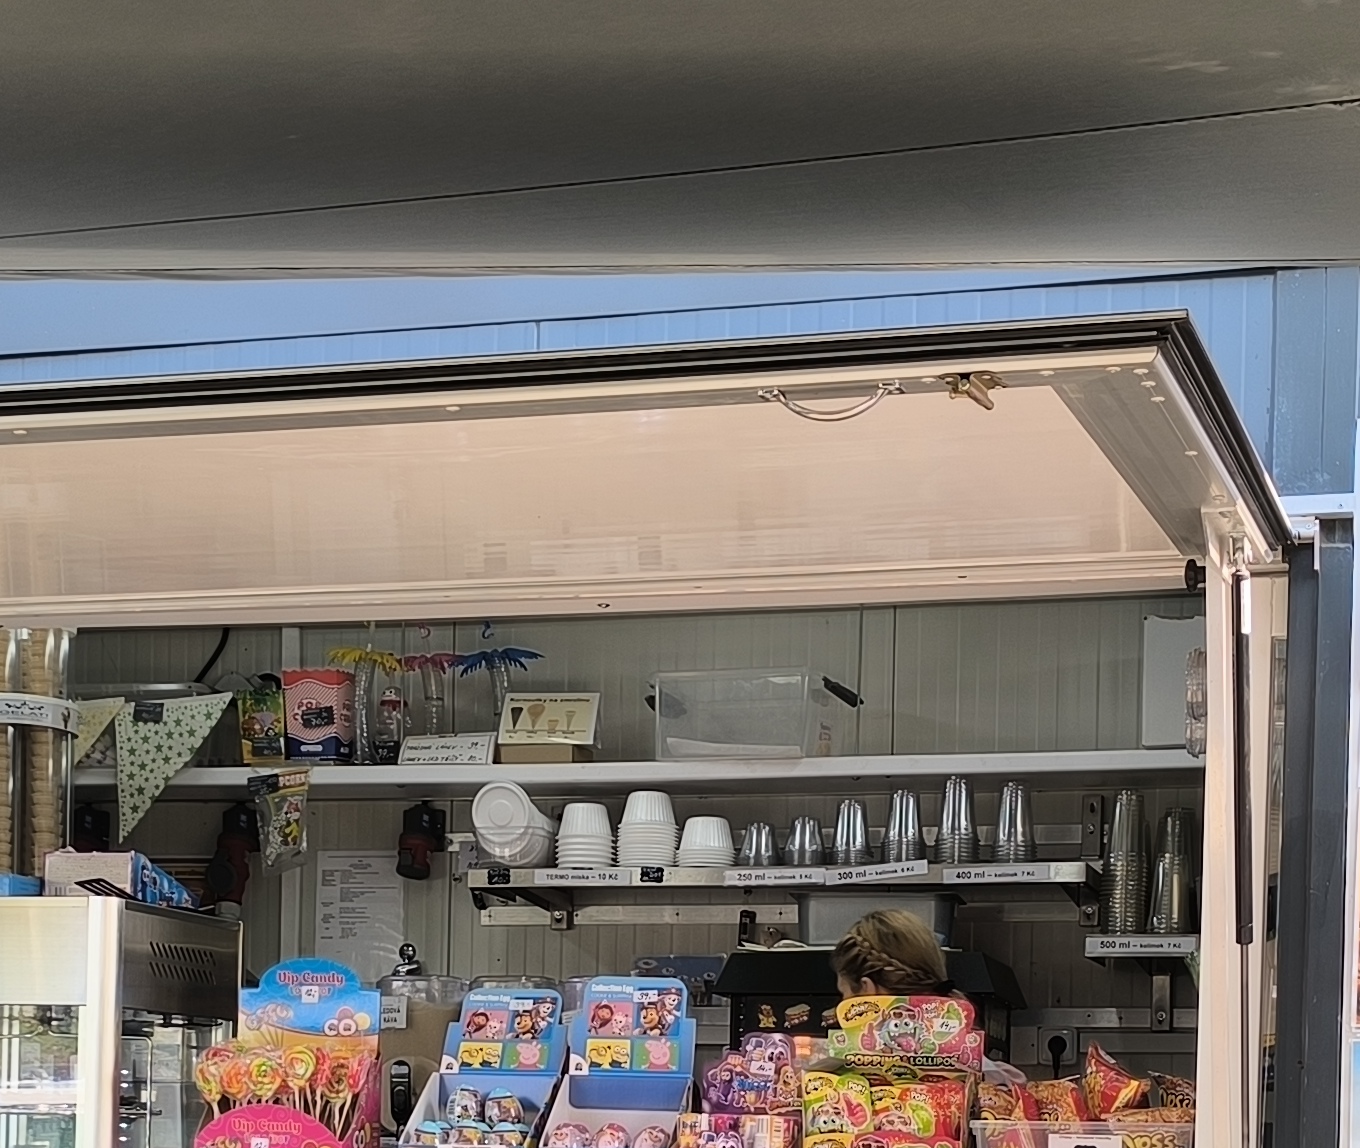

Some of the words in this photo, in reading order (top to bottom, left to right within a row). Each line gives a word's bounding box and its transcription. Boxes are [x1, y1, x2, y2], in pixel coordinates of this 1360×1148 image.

[737, 873, 752, 881] 250
[838, 872, 853, 880] 300
[856, 870, 866, 878] ml
[956, 871, 972, 879] 400
[302, 972, 344, 986] Candy
[846, 1055, 901, 1066] POPPING
[848, 1081, 866, 1094] POP!
[911, 1091, 930, 1102] POP!
[257, 1119, 301, 1133] Candy
